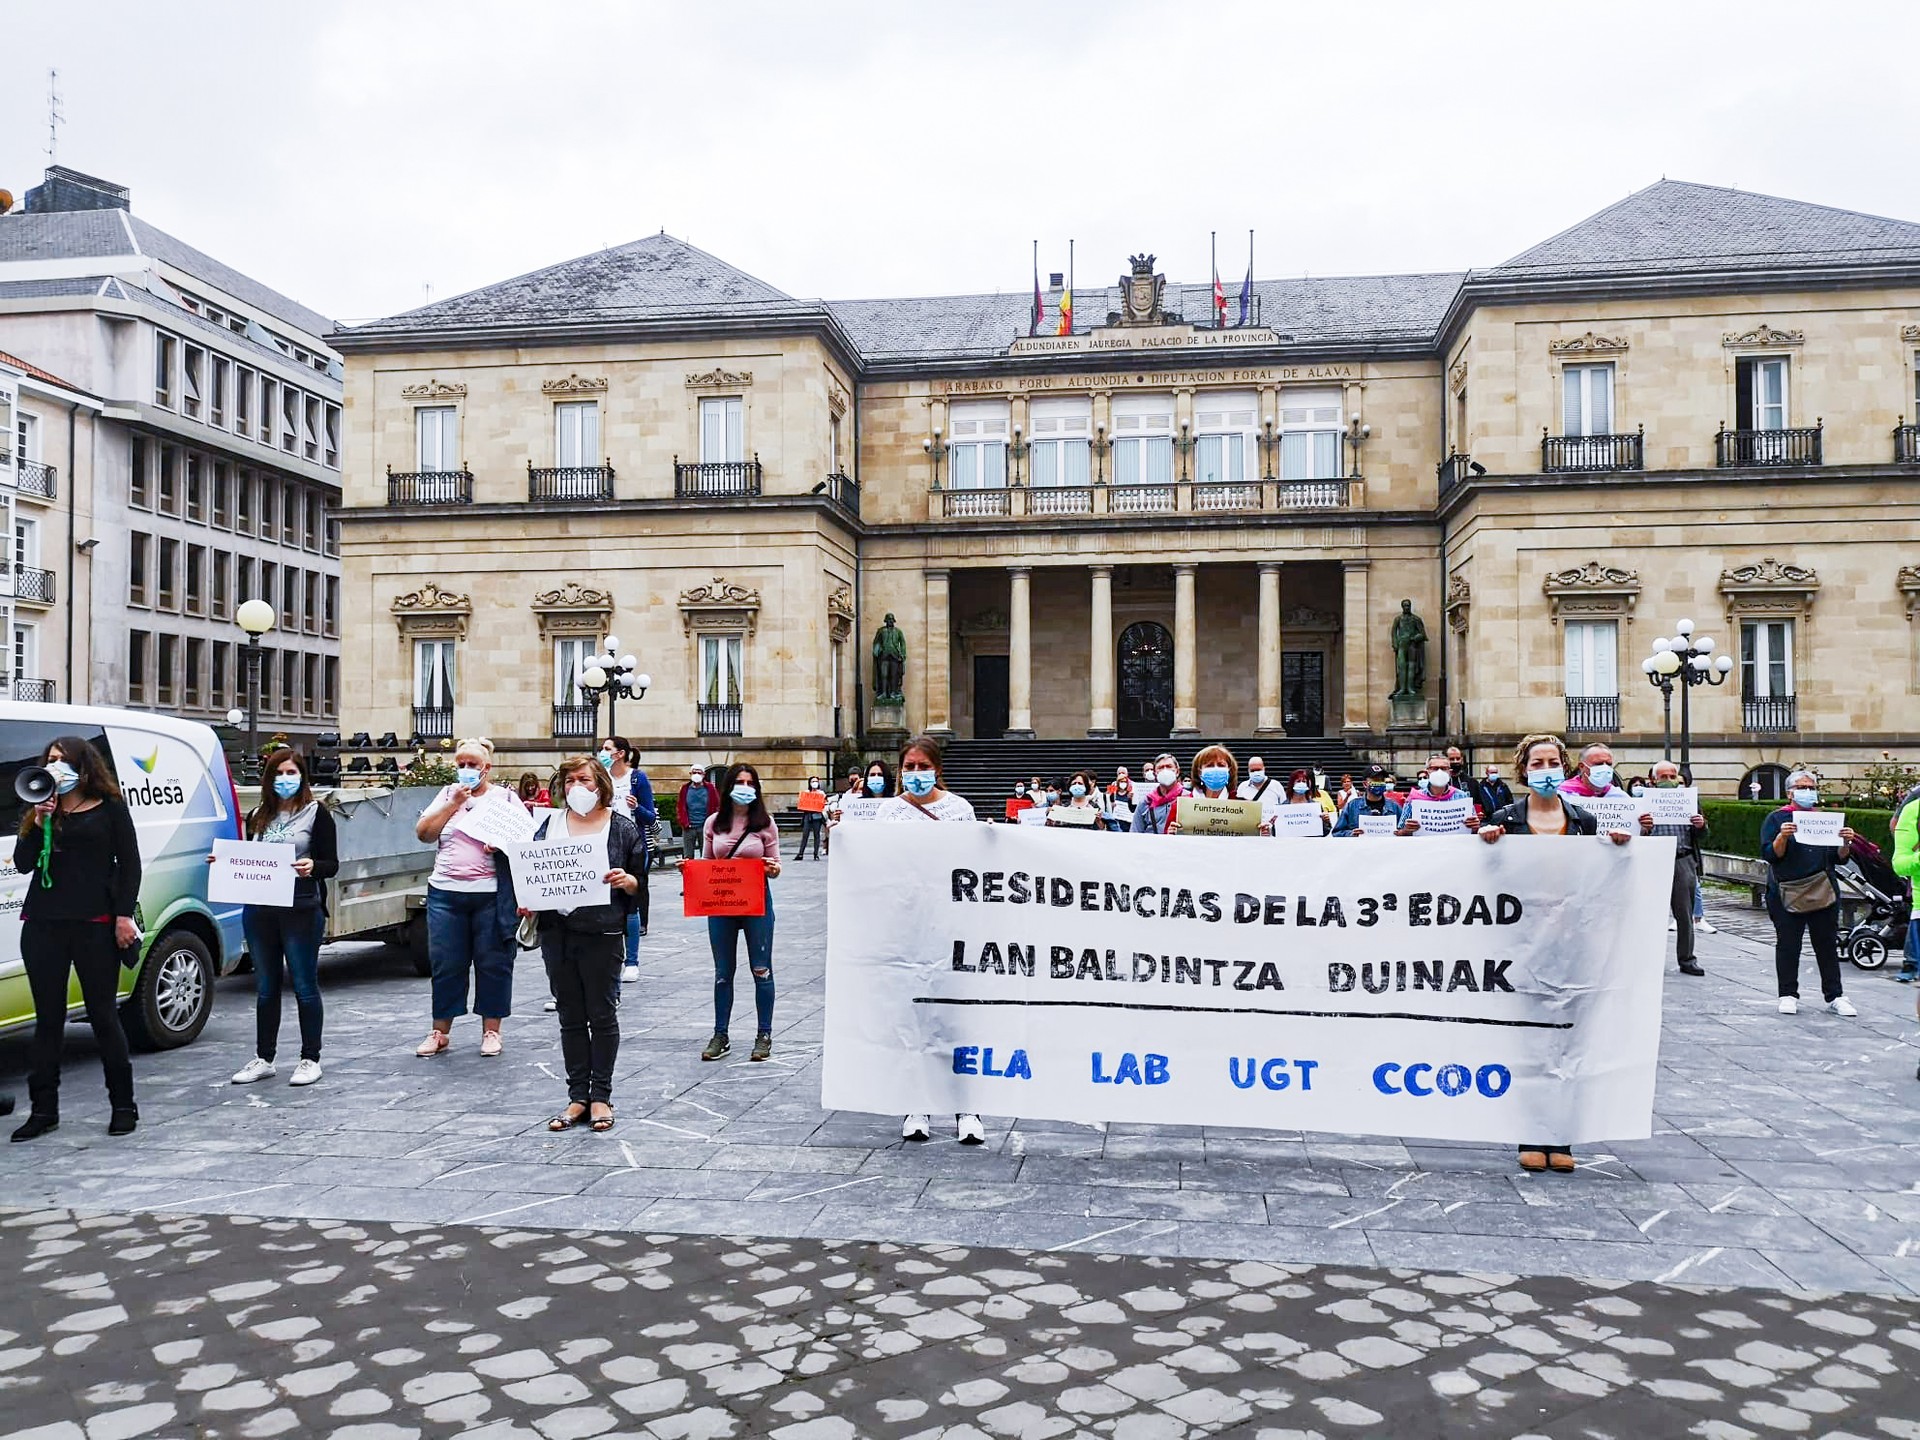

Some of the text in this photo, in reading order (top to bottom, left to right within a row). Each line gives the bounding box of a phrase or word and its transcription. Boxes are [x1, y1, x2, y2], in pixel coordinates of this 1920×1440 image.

[1013, 333, 1274, 352] ALDUNDIAREN JAUREGIA PALACIO DE LA PROVINCIA
[946, 366, 1351, 392] ARABAKO FORU ALDUNDIA DIPUTACION FORAL DE ALAVA
[121, 778, 184, 807] indesa
[848, 802, 882, 810] KALITATEZ
[1210, 817, 1228, 826] gara
[1649, 811, 1692, 819] SCLAVIZADO
[476, 821, 513, 843] PRECARIO
[1193, 827, 1205, 835] lan
[520, 843, 593, 860] KALITATEZKO
[230, 857, 278, 868] RESIDENCIAS
[0, 865, 18, 876] ndes
[234, 871, 272, 882] EN LUCHA
[526, 870, 597, 885] KALITATEZKO
[541, 885, 588, 897] ZAINTZA
[0, 899, 24, 910] ndesa
[951, 868, 1523, 928] RESIDENCIAS DE LA 3ª EDAD
[952, 940, 1516, 994] LAN BALDINTZA DUINAK
[952, 1046, 1512, 1098] ELA LAB UGT CCOO
